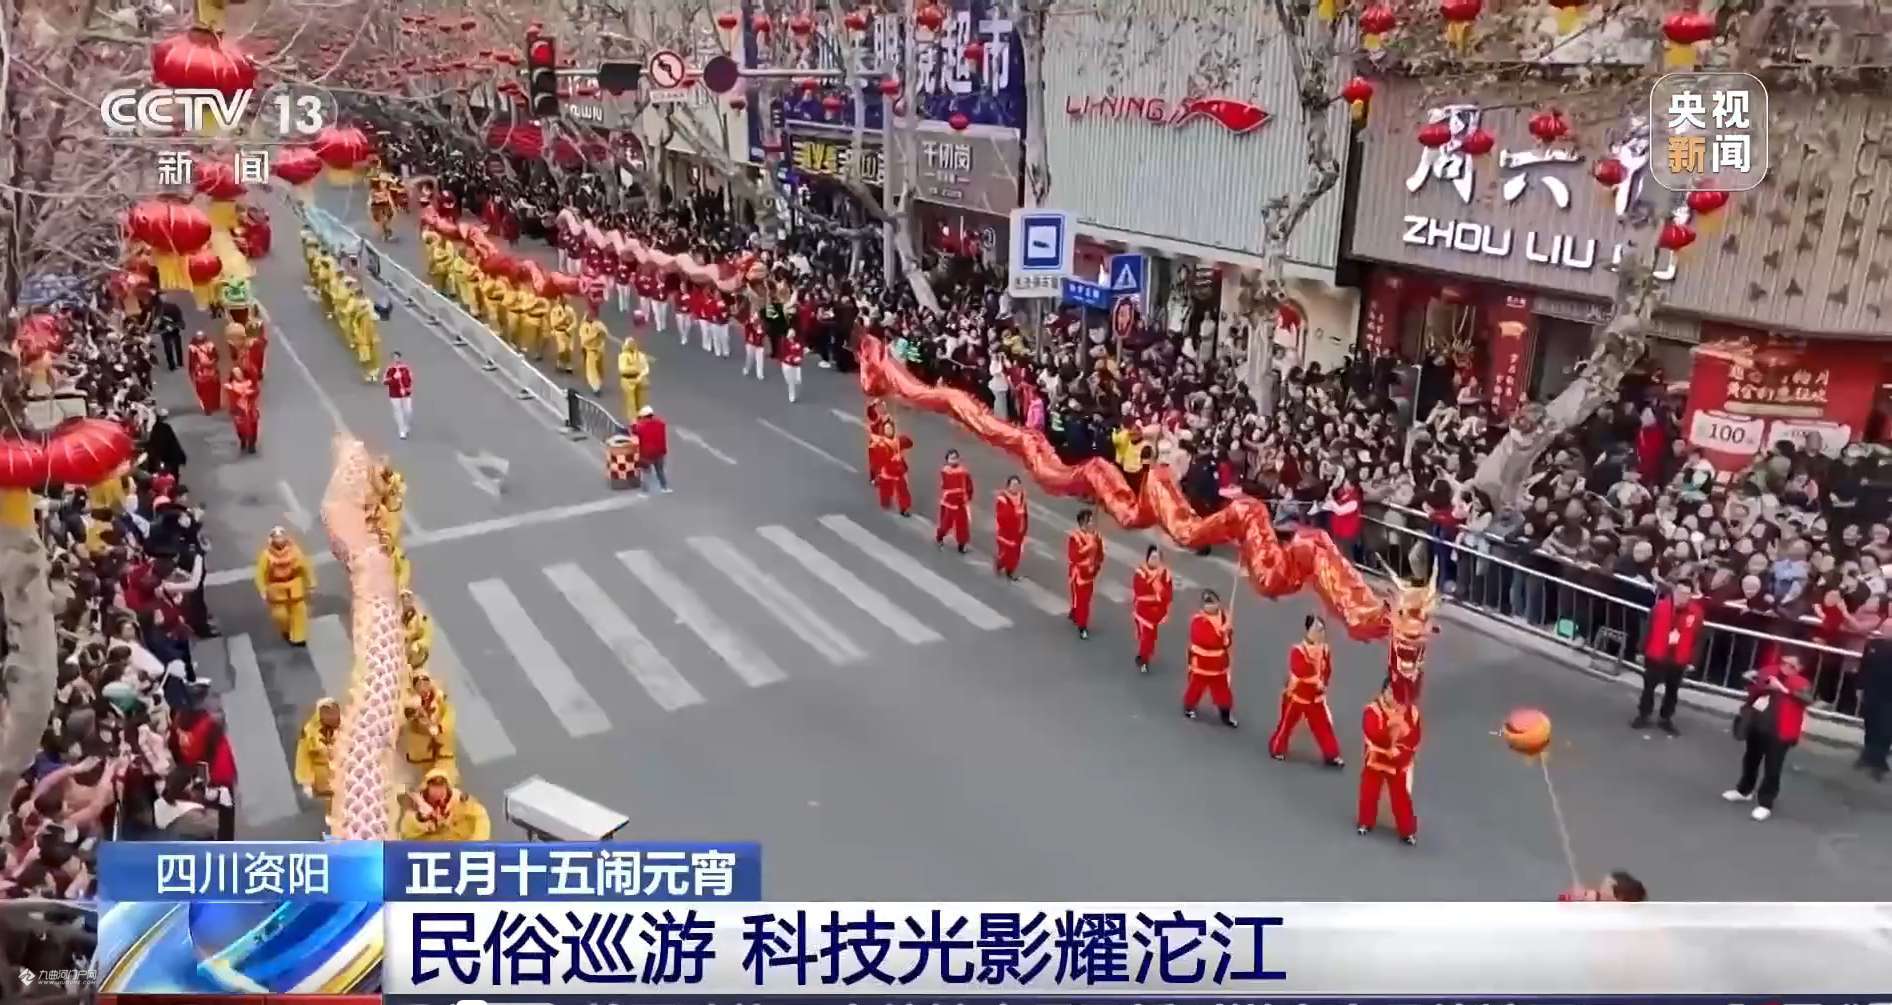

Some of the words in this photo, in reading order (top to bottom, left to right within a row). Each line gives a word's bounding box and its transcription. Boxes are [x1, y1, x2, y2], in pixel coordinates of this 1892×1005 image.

[1065, 95, 1165, 123] LI-NING
[1403, 215, 1511, 256] ZHOU
[1526, 231, 1596, 269] LIU
[1709, 423, 1745, 443] 100
